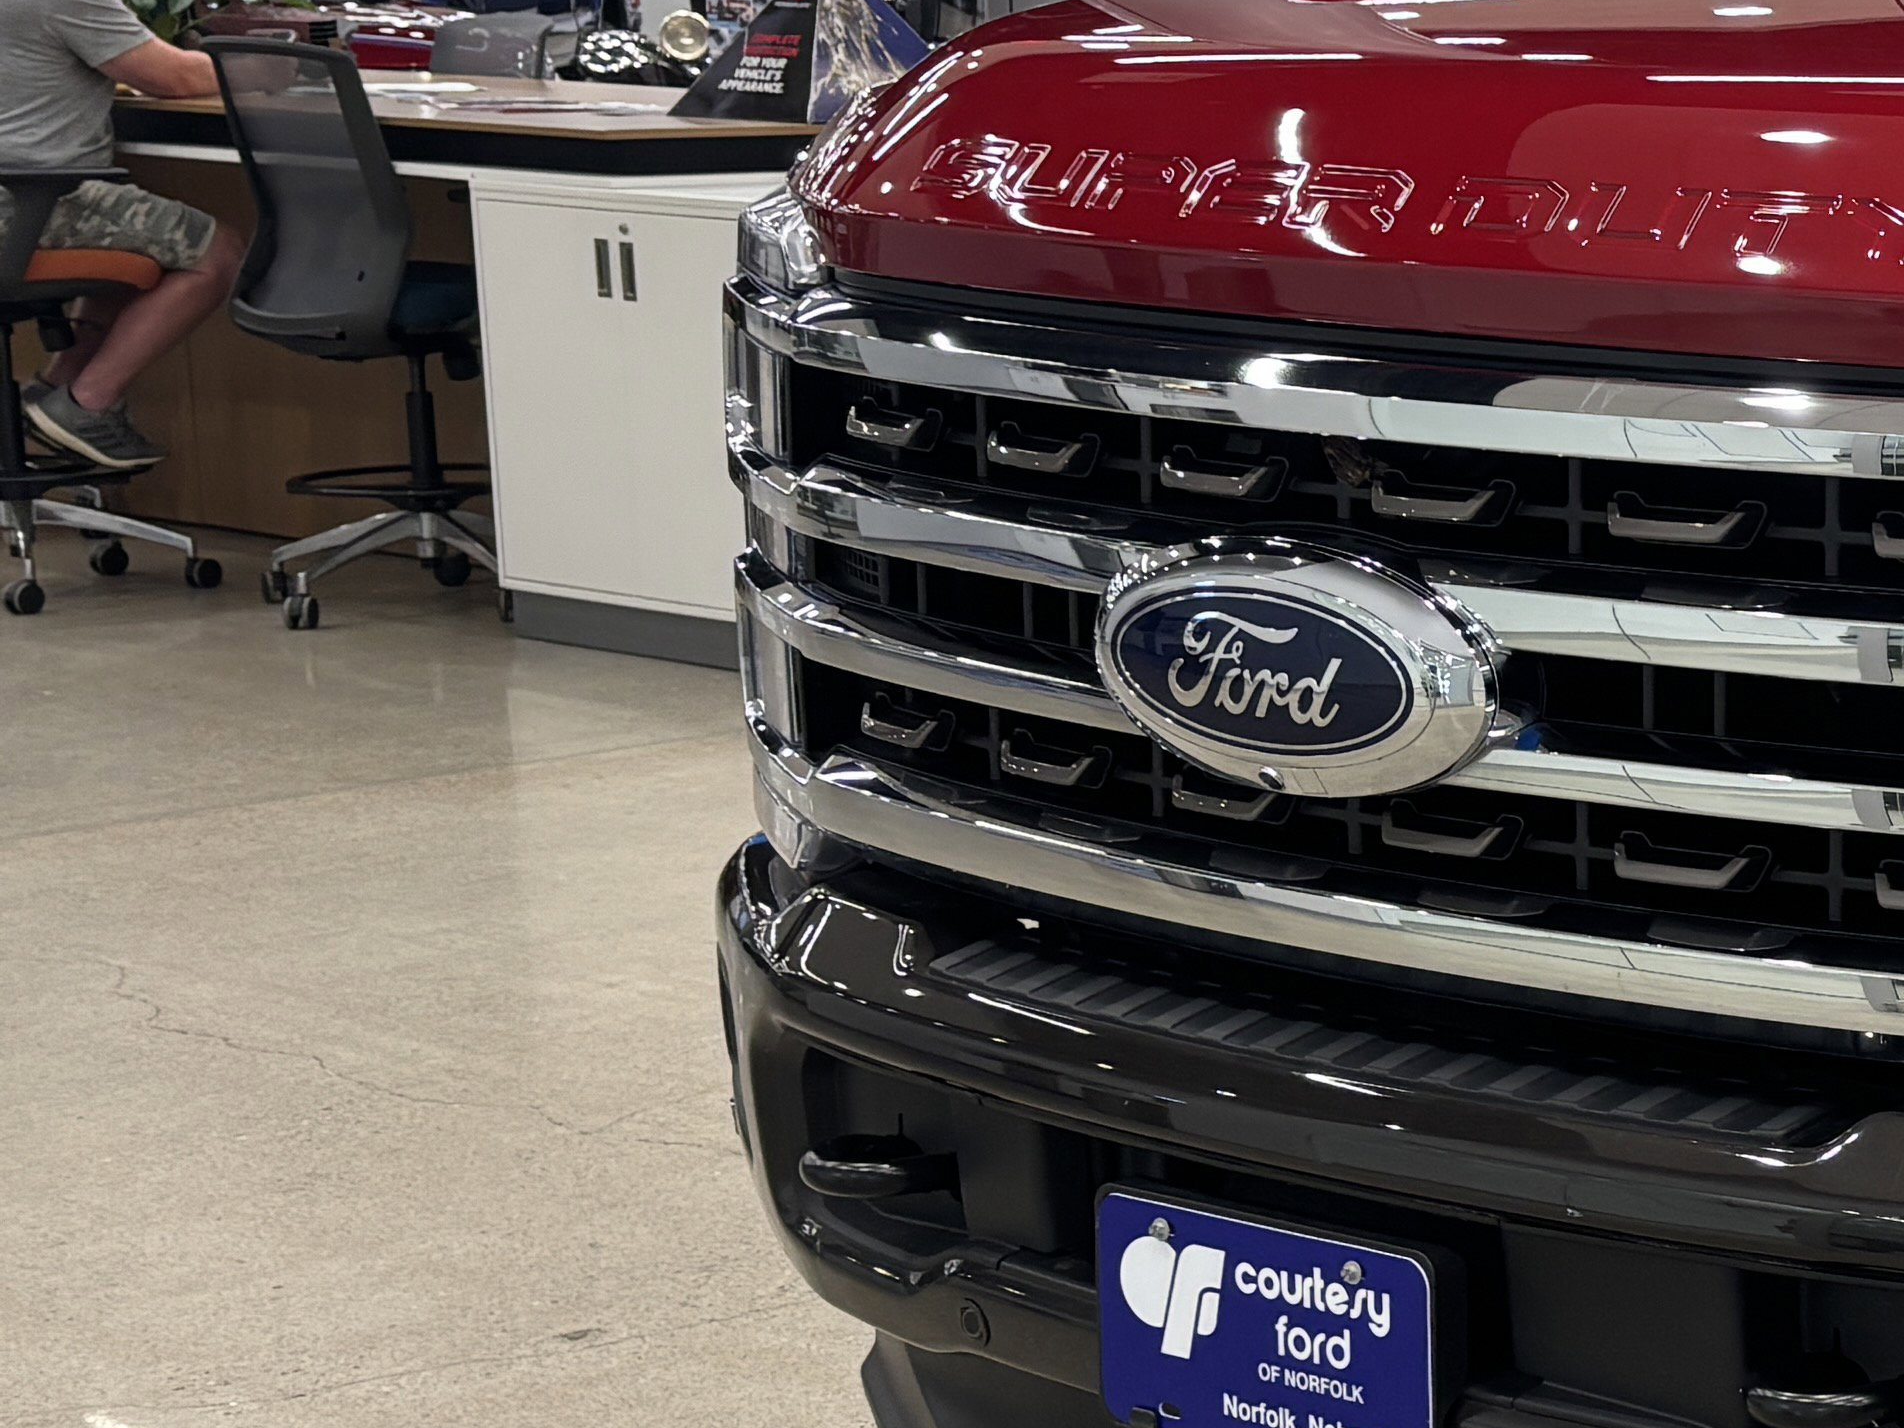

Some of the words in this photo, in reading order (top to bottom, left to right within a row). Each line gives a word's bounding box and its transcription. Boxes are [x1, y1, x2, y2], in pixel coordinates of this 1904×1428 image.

[740, 56, 761, 68] FOR
[761, 57, 788, 69] YOUR
[910, 133, 1415, 233] SUPER
[1167, 610, 1341, 729] Ford
[1234, 1261, 1392, 1338] courtesy
[1274, 1314, 1352, 1371] ford
[1257, 1361, 1281, 1384] OF
[1283, 1368, 1364, 1405] NORFOLK
